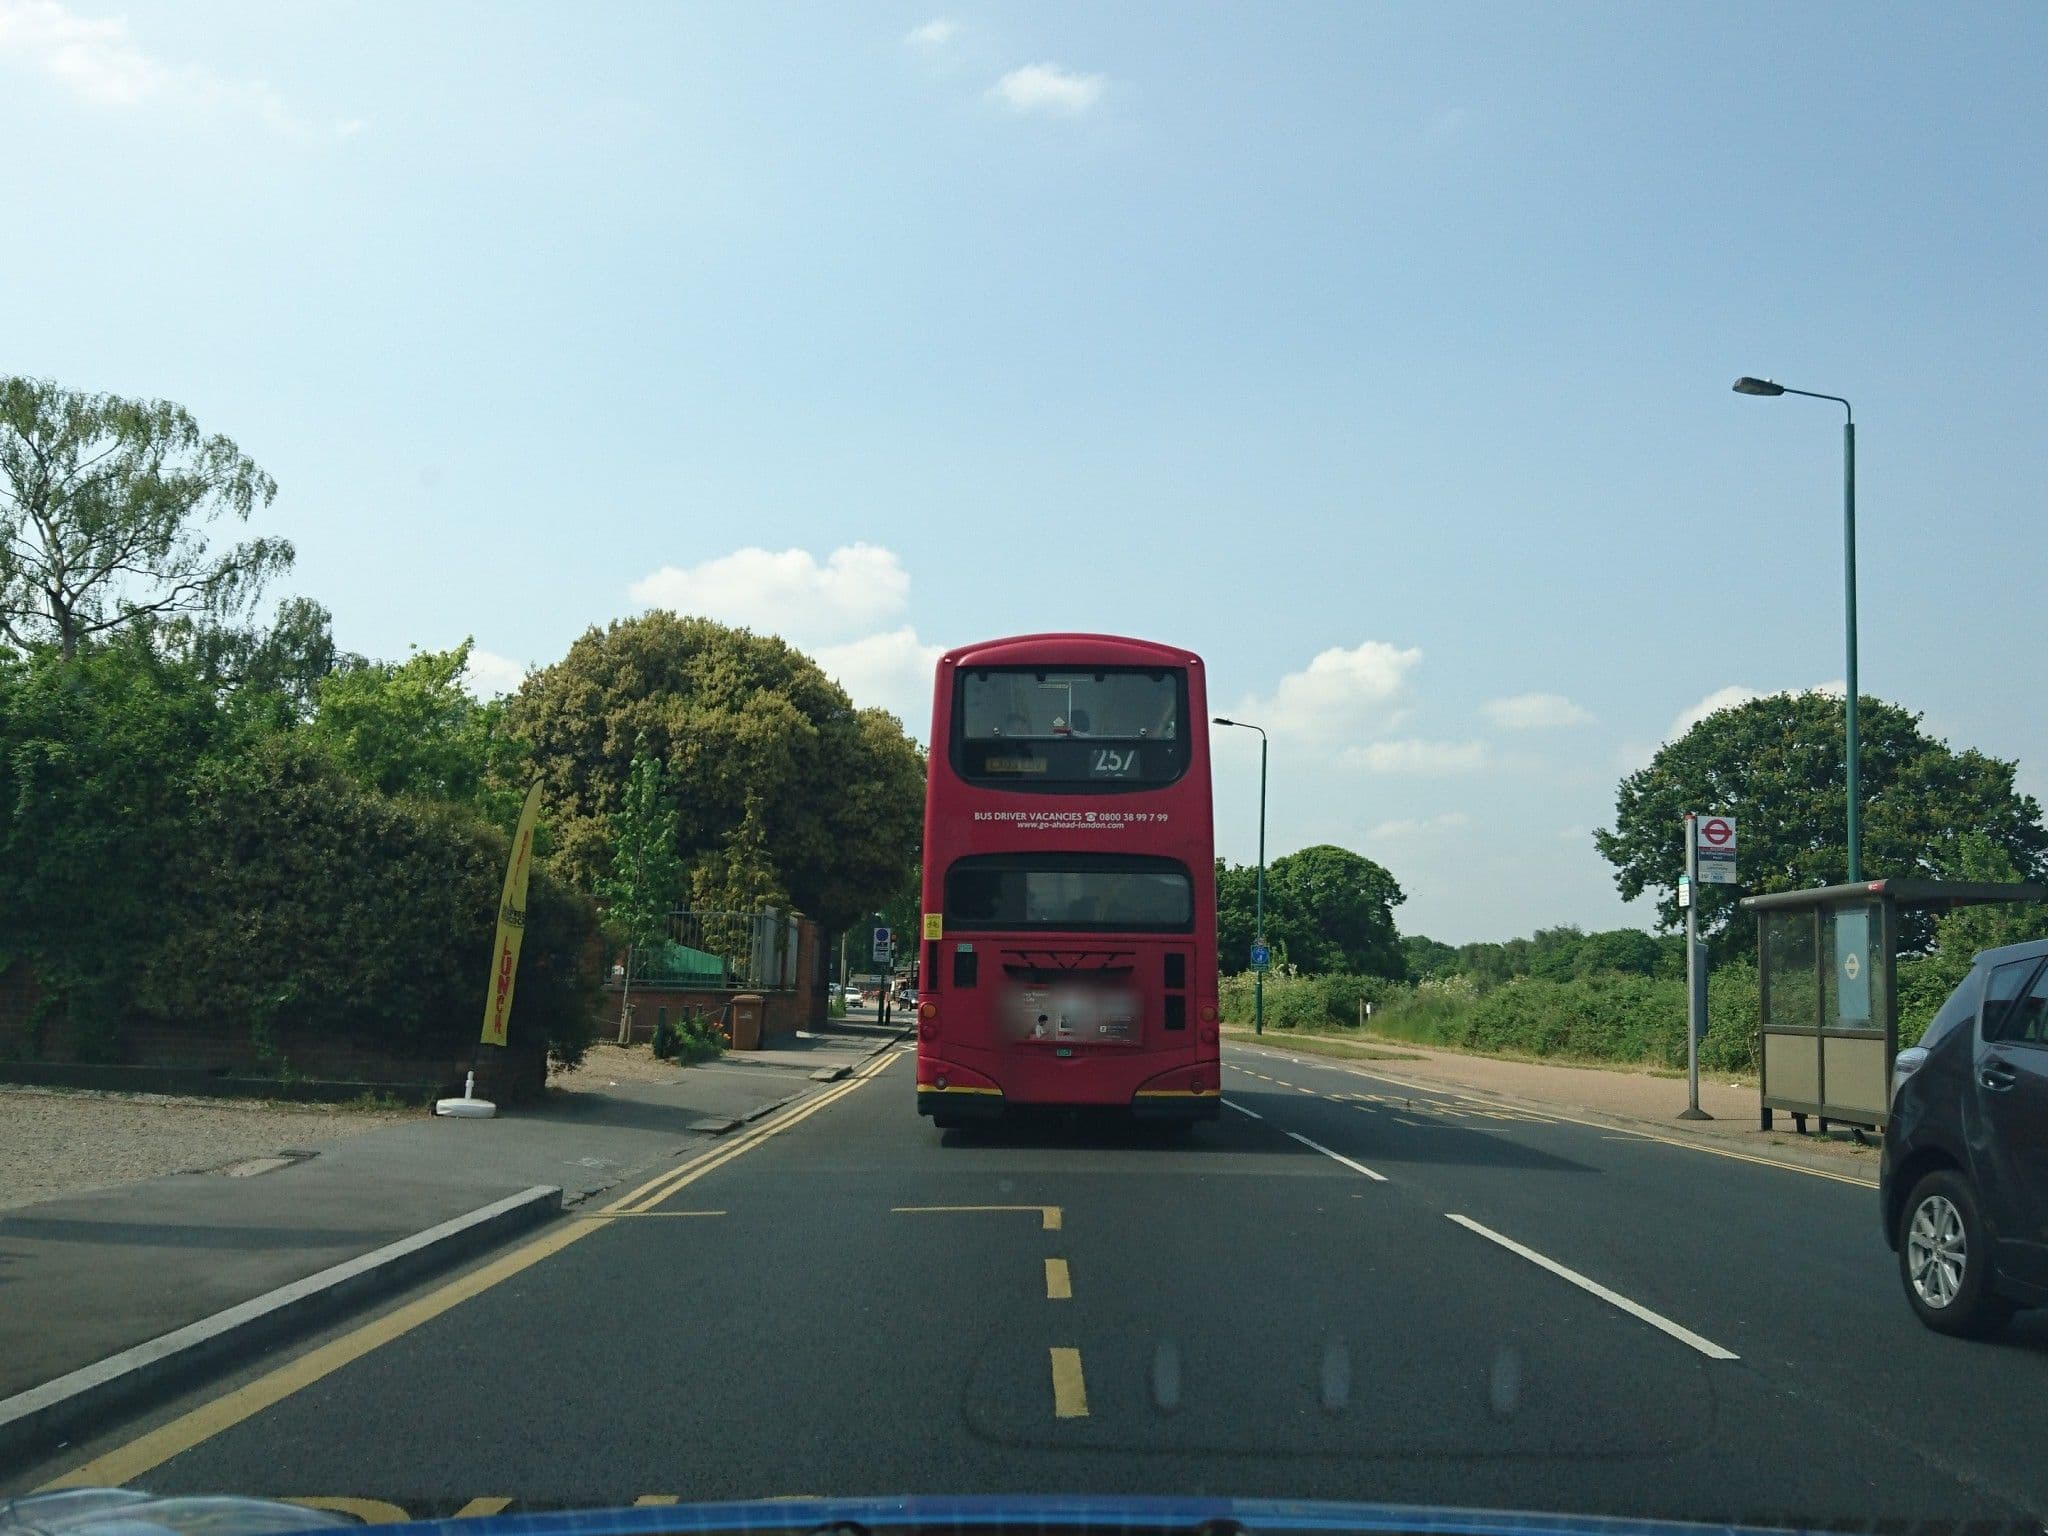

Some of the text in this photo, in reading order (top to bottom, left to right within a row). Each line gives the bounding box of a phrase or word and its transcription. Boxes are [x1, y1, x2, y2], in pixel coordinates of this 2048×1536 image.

[974, 811, 1169, 822] BUS DRIVER VACANCIES 0800 38 99 7 99
[1017, 821, 1125, 830] www.go-ahead-london.com
